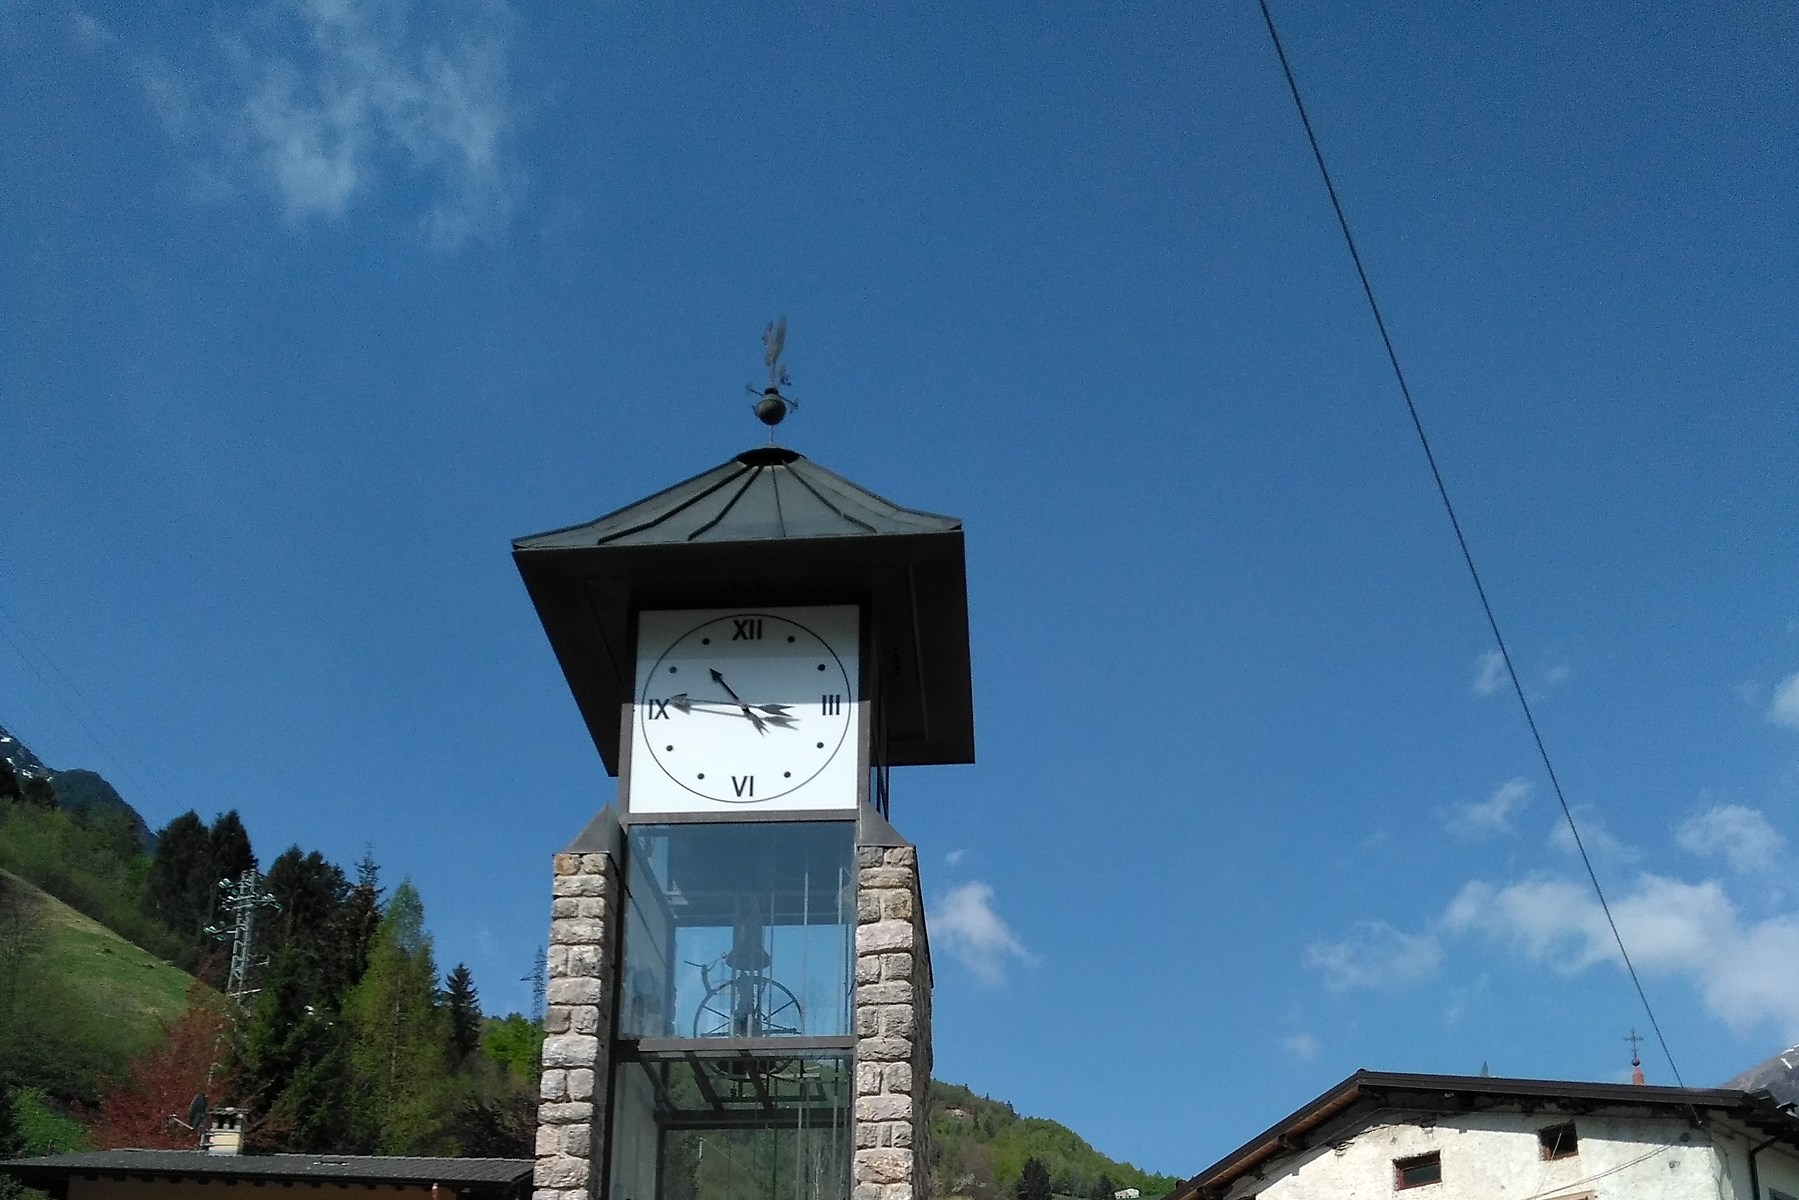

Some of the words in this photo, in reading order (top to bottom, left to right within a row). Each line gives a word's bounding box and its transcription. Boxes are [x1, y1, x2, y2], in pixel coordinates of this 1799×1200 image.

[732, 619, 762, 640] XII
[648, 698, 671, 720] IX
[822, 694, 841, 715] III
[731, 775, 754, 797] VI
